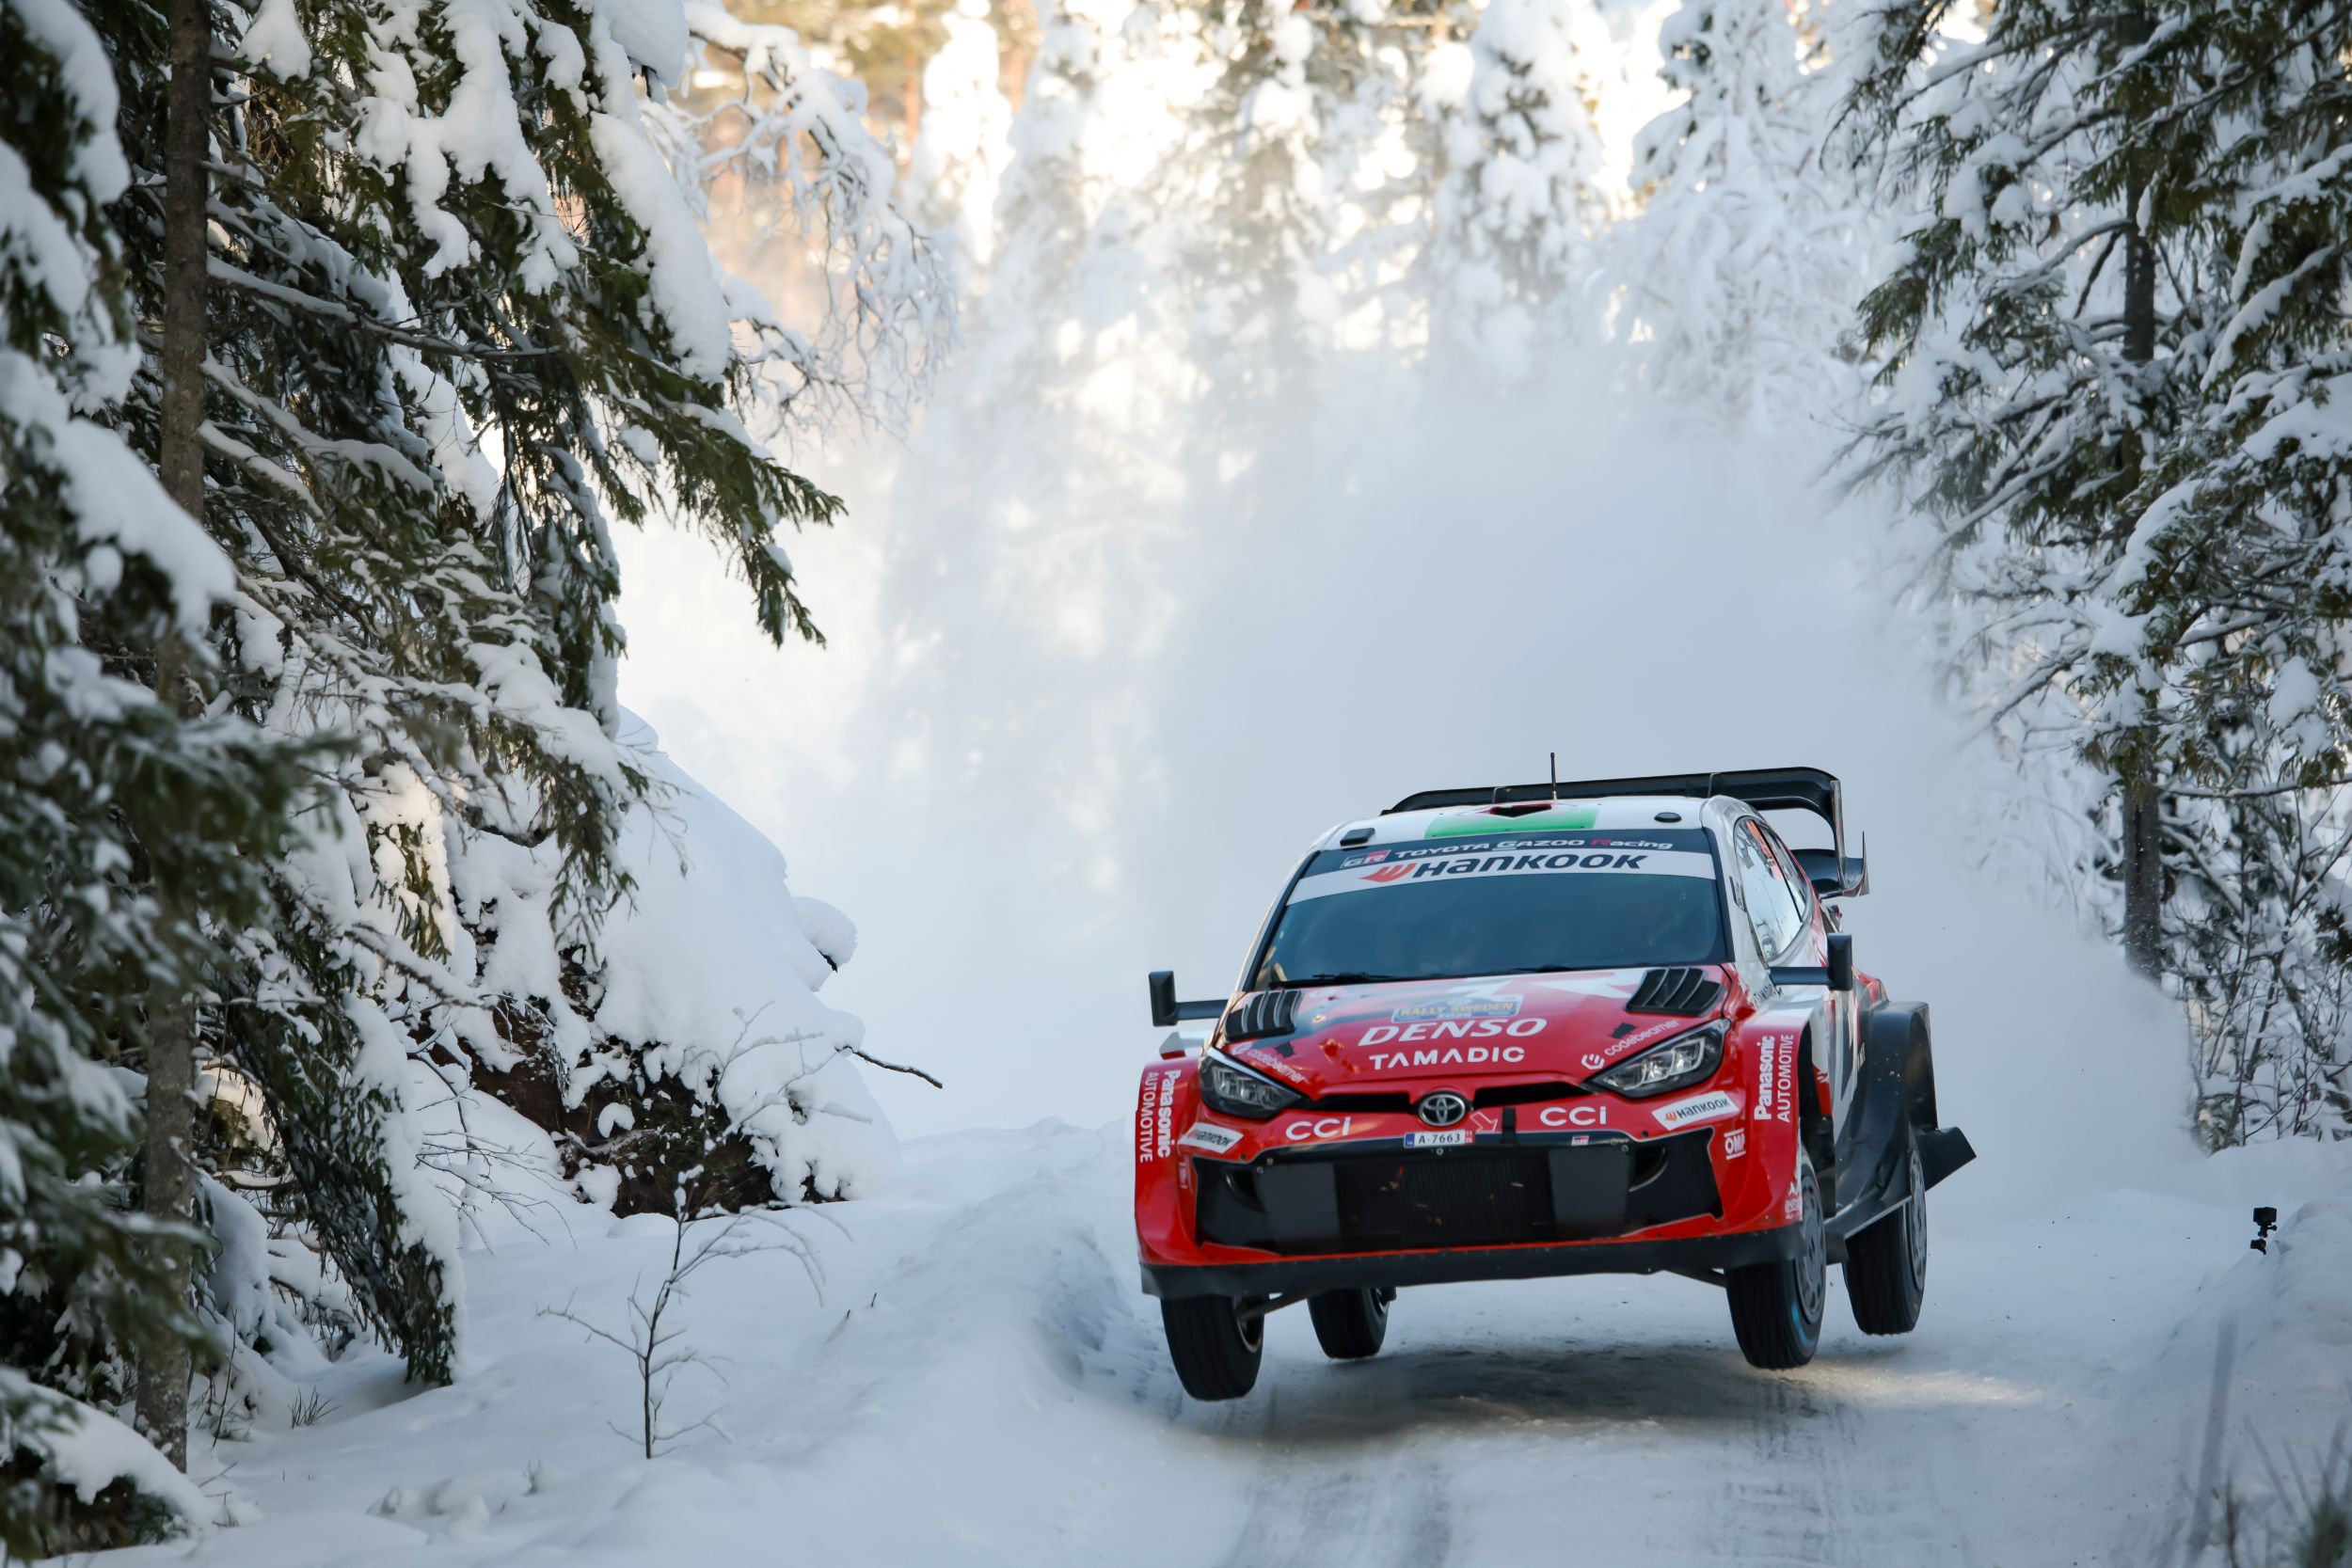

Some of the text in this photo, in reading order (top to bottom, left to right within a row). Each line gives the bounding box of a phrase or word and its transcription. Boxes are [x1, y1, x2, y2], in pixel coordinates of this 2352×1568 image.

[1343, 838, 1673, 867] GR TOYOTA GAZOO Racing
[1400, 1006, 1447, 1017] RALLY
[1450, 1002, 1514, 1013] SWEDEN
[1358, 1018, 1548, 1046] DENSO
[1604, 1020, 1679, 1056] codebeamer
[1369, 1046, 1525, 1069] TAMADIC
[1754, 1036, 1775, 1119] Panasonic
[1777, 1034, 1794, 1123] AUTOMOTIVE
[1139, 1071, 1159, 1163] AUTOMOTIVE
[1157, 1069, 1182, 1158] Panasonic
[1418, 1132, 1460, 1145] A-7663
[1724, 1132, 1746, 1154] OMP
